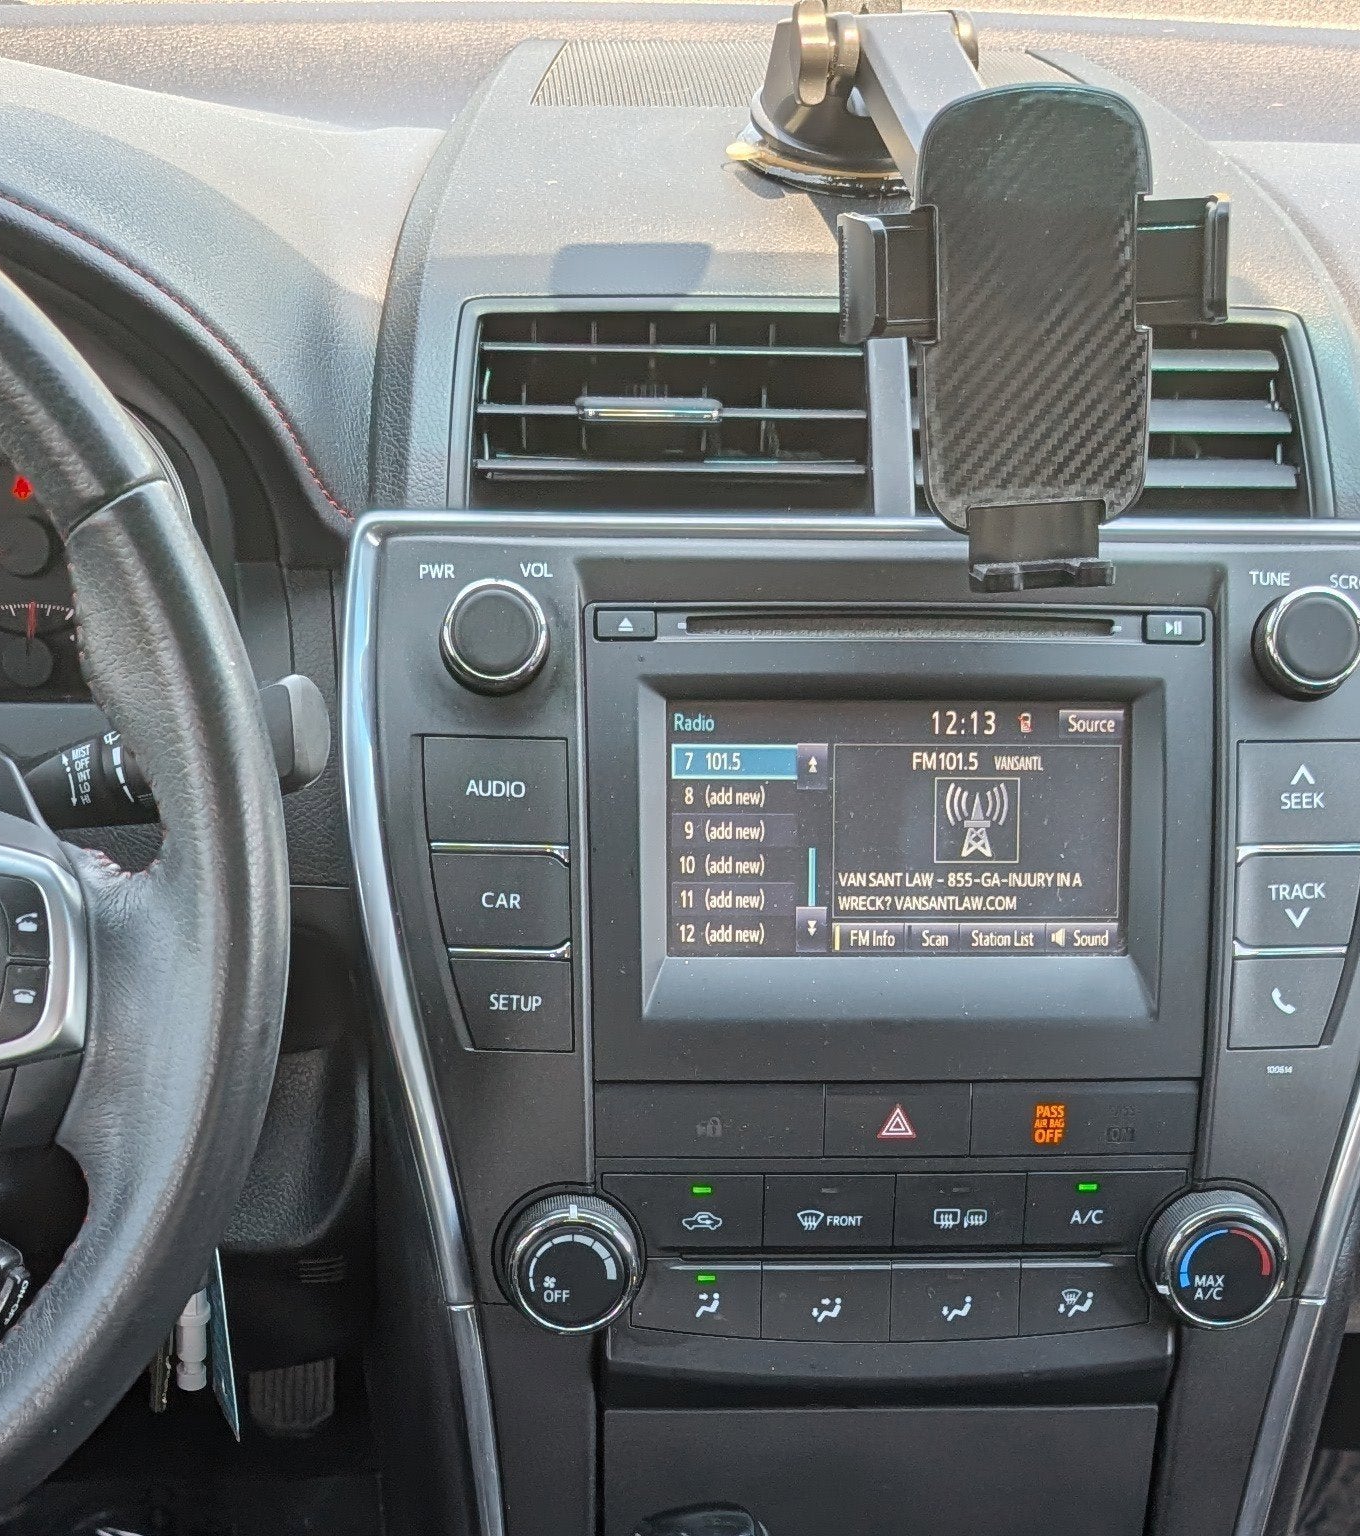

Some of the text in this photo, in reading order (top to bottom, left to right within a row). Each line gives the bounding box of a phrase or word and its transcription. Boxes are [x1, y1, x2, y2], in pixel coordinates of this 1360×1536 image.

[419, 564, 455, 579] PWR
[519, 562, 554, 578] VOL
[1248, 570, 1290, 587] TUNE
[673, 713, 715, 732] Radio
[931, 710, 997, 736] 12:13
[1068, 714, 1116, 733] Source
[71, 743, 91, 760] MIST
[74, 756, 91, 772] OFF
[684, 752, 741, 771] 7 101.5
[76, 768, 91, 783] INT
[465, 779, 526, 798] AUDIO
[684, 785, 765, 807] 8 (add new)
[1280, 791, 1326, 810] SEEK
[684, 820, 765, 841] 9 (add new)
[679, 854, 765, 876] 10 (add new)
[837, 872, 867, 887] VAN
[868, 872, 903, 887] SANT
[905, 872, 935, 887] LAW
[947, 872, 1055, 888] 855-GA-INJURY
[1056, 872, 1071, 887] IN
[1071, 872, 1083, 888] A
[680, 888, 765, 910] 11 (add new)
[1267, 882, 1326, 901] TRACK
[481, 892, 521, 910] CAR
[837, 895, 1017, 911] WRECK? VANSANTLAW.COM
[679, 922, 765, 944] 12 (add new)
[850, 929, 896, 947] FM Info
[921, 929, 949, 947] Scan
[971, 929, 1035, 947] Station List
[1073, 929, 1109, 947] Sound
[489, 993, 542, 1012] SETUP
[1036, 1104, 1065, 1118] PASS
[1034, 1128, 1063, 1144] OFF
[826, 1214, 863, 1227] FRONT
[1069, 1209, 1104, 1225] A/C
[1193, 1274, 1225, 1288] MAX
[543, 1289, 571, 1304] OFF
[1193, 1287, 1224, 1301] A/C
